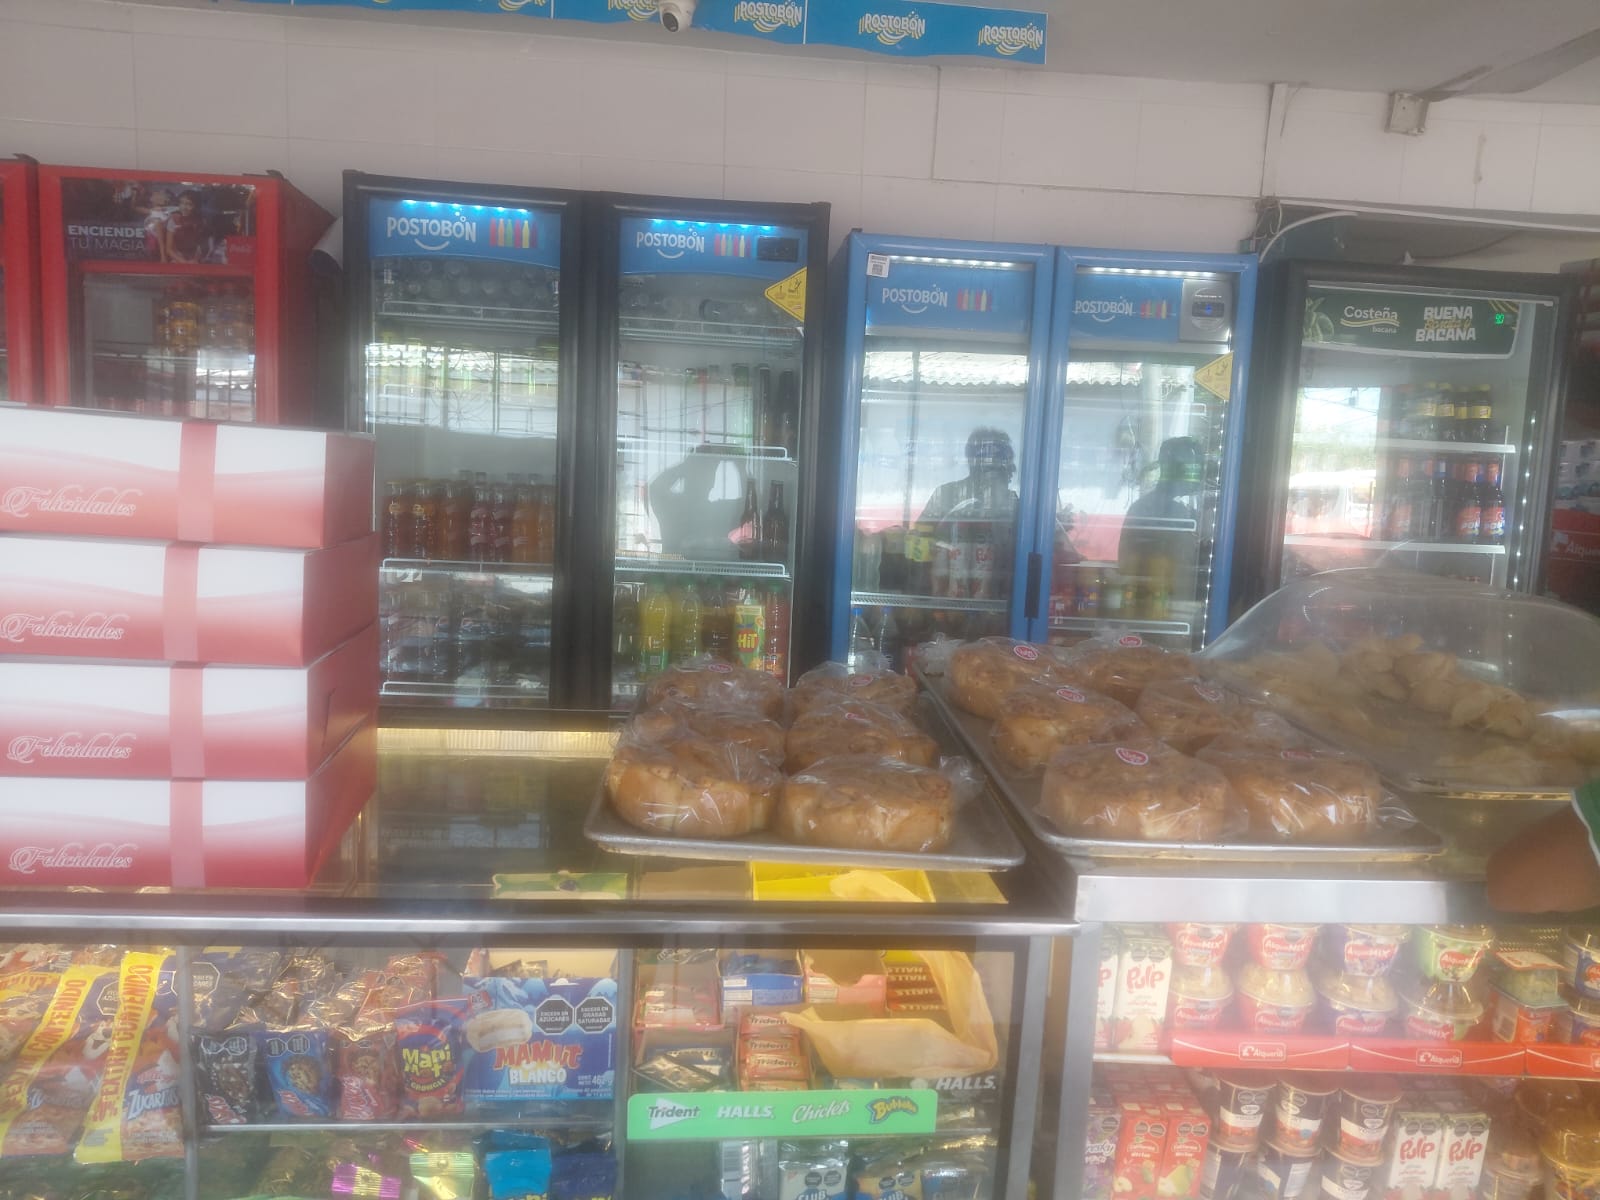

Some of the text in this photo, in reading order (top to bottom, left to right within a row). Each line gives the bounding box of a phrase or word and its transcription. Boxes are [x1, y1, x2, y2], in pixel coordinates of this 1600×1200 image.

[67, 225, 146, 239] ENCIENDE
[69, 237, 146, 251] TU MAGIA
[1343, 305, 1399, 320] Costeña
[1423, 306, 1473, 320] BUENA
[1415, 327, 1477, 342] BACANA
[0, 484, 143, 519] Felicidades
[0, 610, 130, 643] Felicidades
[7, 731, 137, 764] Felicidades
[8, 842, 138, 874] Felicidades
[112, 965, 154, 1042] CONTENIDO
[27, 980, 88, 1052] CONTENIDO
[493, 1039, 583, 1071] MAMUT
[509, 1066, 568, 1086] BLANCO
[647, 1104, 701, 1119] Trident
[717, 1104, 776, 1120] HALLS
[791, 1100, 852, 1123] Chiclets
